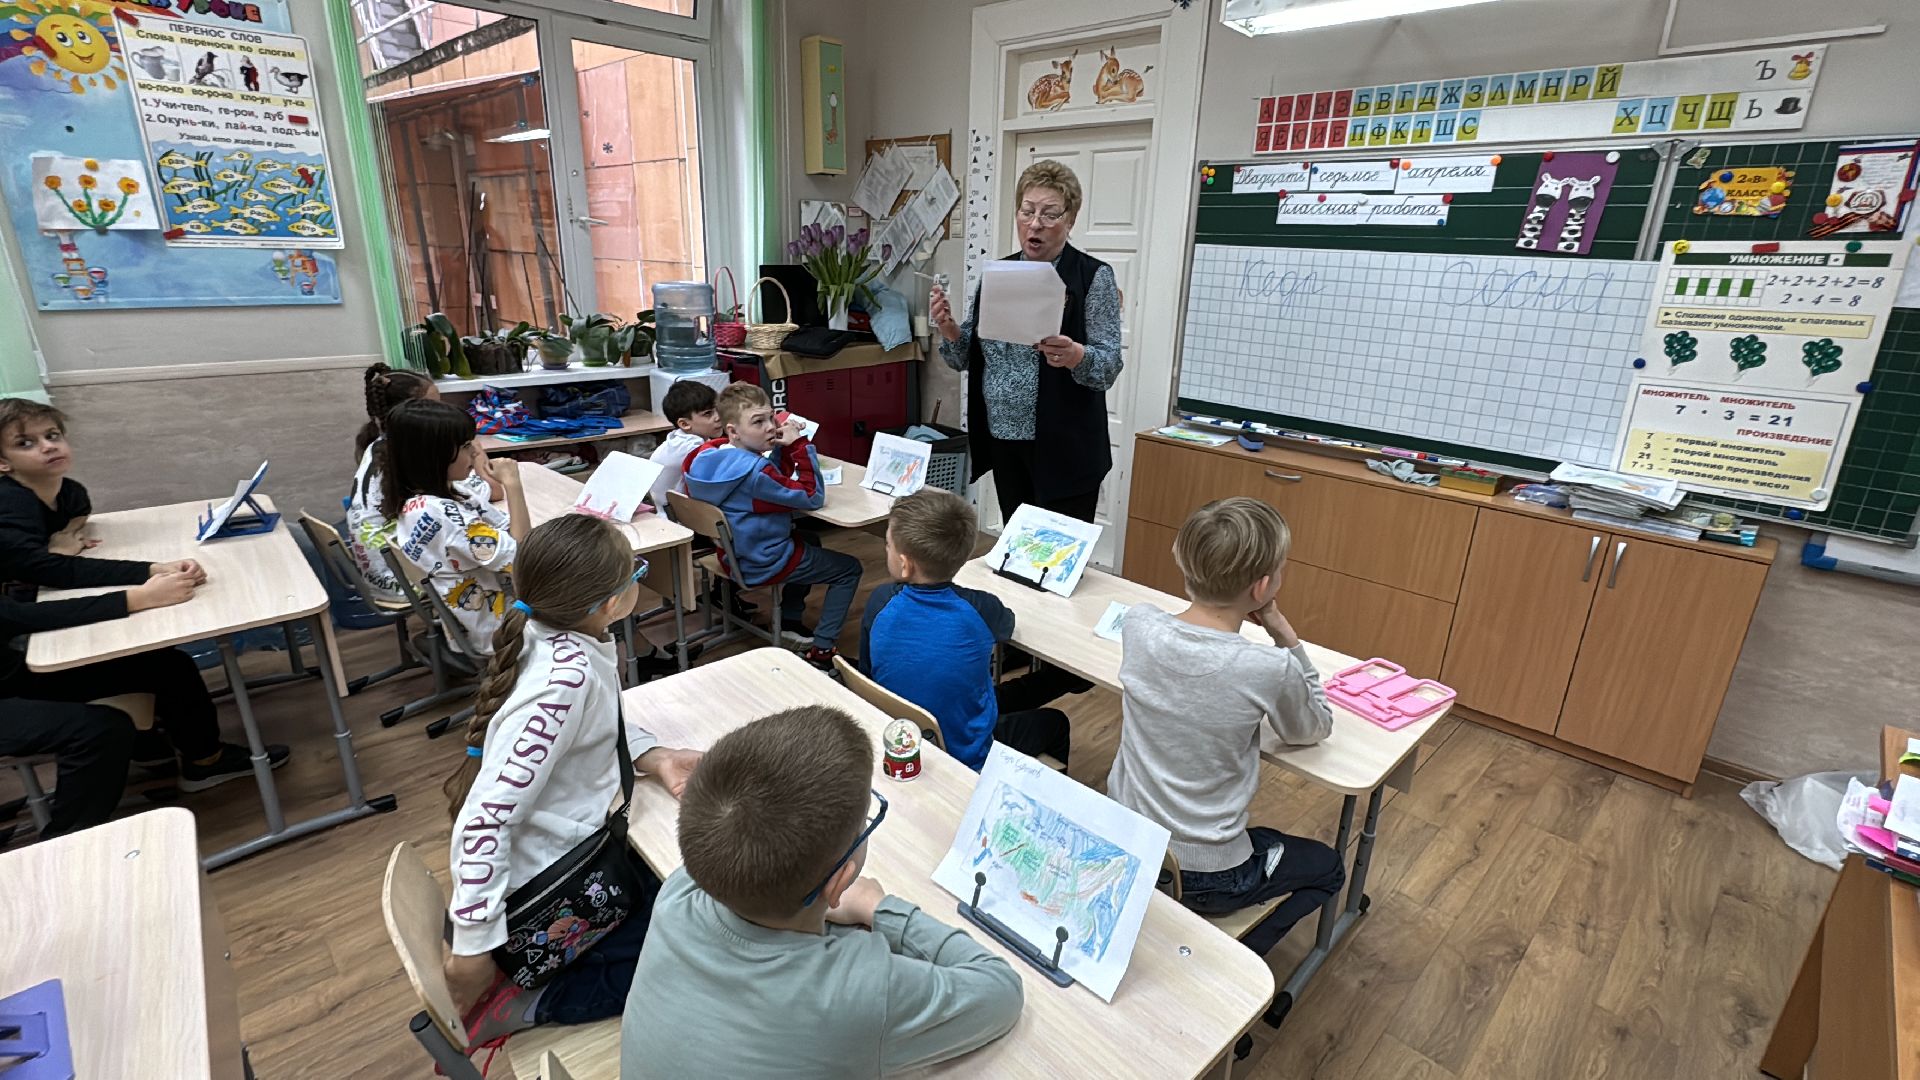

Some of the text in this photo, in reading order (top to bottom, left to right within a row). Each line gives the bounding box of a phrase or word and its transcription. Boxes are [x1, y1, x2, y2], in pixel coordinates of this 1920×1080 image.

[136, 29, 296, 58] Слова переноси по слогам
[169, 23, 263, 44] ПЕРЕНОС СЛОВ
[1356, 95, 1370, 112] Б
[1376, 93, 1391, 110] В
[1398, 90, 1413, 108] Г
[1418, 87, 1438, 106] Д
[1440, 85, 1462, 104] Ж
[1490, 81, 1508, 100] Л
[1514, 79, 1535, 98] М
[1542, 76, 1563, 96] Н
[1573, 74, 1588, 94] Р
[1598, 68, 1618, 93] Й
[1756, 60, 1776, 81] Ъ
[264, 110, 284, 122] дуб
[1351, 124, 1365, 140] П
[1372, 122, 1386, 140] Ф
[1394, 122, 1408, 138] К
[1416, 120, 1430, 138] Т
[1436, 118, 1456, 136] Ш
[1462, 117, 1476, 134] С
[1616, 106, 1638, 127] Х
[1647, 104, 1666, 126] Ц
[1682, 102, 1700, 122] Ч
[1707, 100, 1734, 124] Щ
[1234, 164, 1486, 190] Двадцать седьмое апреля
[1726, 188, 1768, 198] КЛАСС
[1366, 196, 1442, 222] работа
[1728, 254, 1826, 265] УМНОЖЕНИЕ
[1239, 259, 1614, 316] Кедр Сосна
[1766, 274, 1886, 290] 2+2+2+2=8
[1780, 293, 1793, 304] 2
[1812, 294, 1825, 306] 4
[1848, 294, 1862, 308] 8
[1642, 388, 1796, 410] МНОЖИТЕЛЬ МНОЖИТЕЛЬ
[1675, 404, 1686, 415] 7
[1724, 410, 1735, 420] 3
[1768, 415, 1794, 427] 21
[1646, 432, 1654, 440] 7
[1676, 436, 1718, 448] первый
[1720, 442, 1786, 458] множитель
[1736, 428, 1834, 447] ПРОИЗВЕДЕНИЕ
[1638, 452, 1651, 460] 21
[1670, 458, 1724, 471] значение
[1644, 442, 1652, 450] 3
[1673, 446, 1712, 458] второй
[1713, 452, 1778, 467] множитель
[1668, 467, 1750, 485] произведение
[1752, 479, 1790, 490] чисел
[460, 801, 518, 886] USPA
[496, 701, 572, 789] USPA
